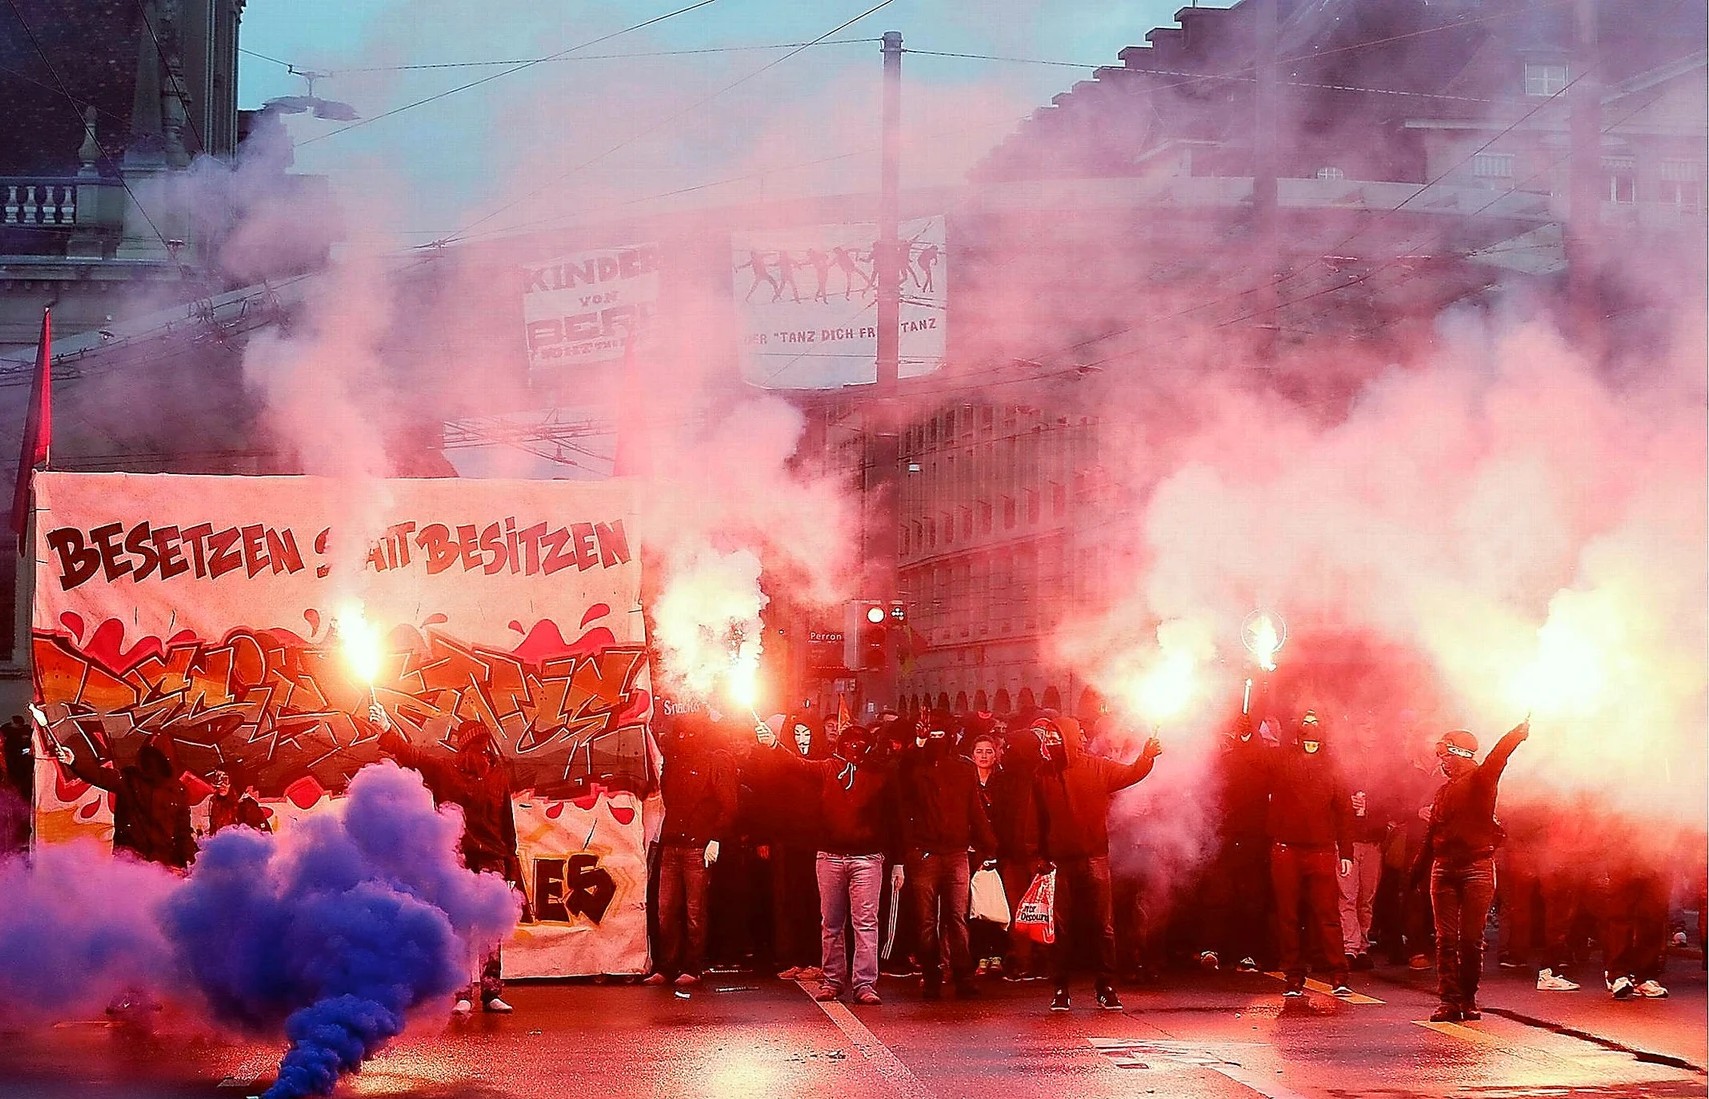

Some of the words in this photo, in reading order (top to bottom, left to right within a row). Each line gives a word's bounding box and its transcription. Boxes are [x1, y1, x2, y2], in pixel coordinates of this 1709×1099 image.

[821, 327, 854, 342] DICH
[859, 327, 876, 339] FR
[46, 520, 306, 592] BESETZEN
[314, 520, 416, 579] SATT
[810, 632, 842, 641] Perron
[519, 853, 617, 926] ES
